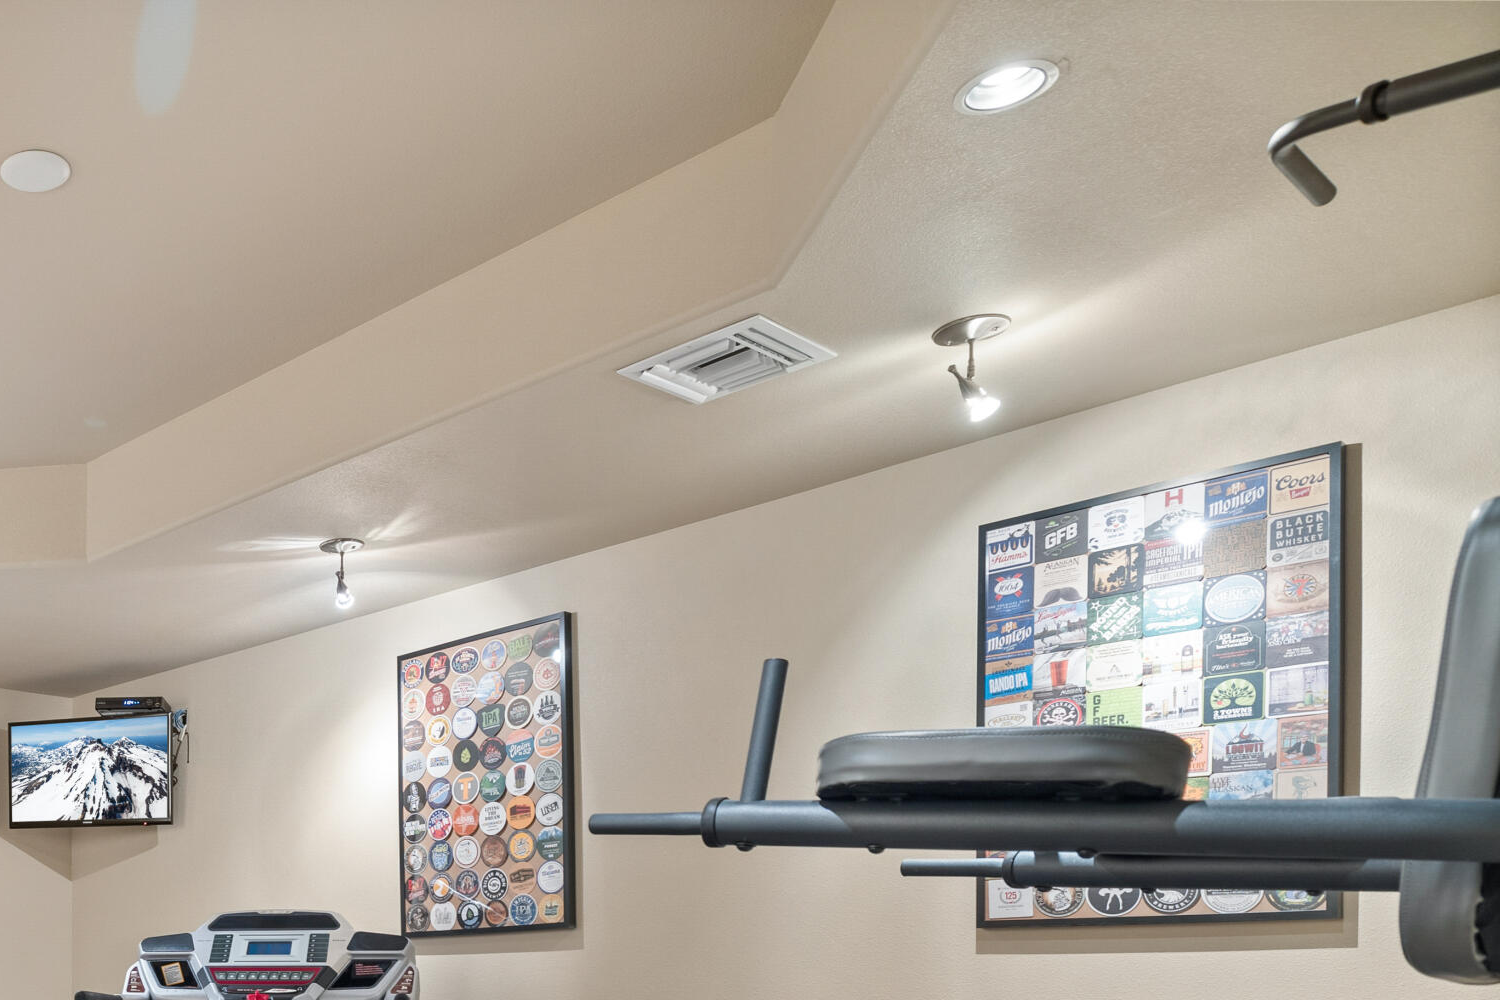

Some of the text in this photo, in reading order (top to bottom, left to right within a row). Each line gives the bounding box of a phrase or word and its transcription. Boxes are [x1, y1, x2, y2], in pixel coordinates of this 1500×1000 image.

[1275, 472, 1325, 491] Coors
[1208, 485, 1265, 518] Montejo
[1275, 512, 1324, 529] BLACK
[1044, 522, 1078, 550] GFB
[1275, 523, 1324, 540] BUTTE
[1275, 533, 1324, 548] WHISKEY
[987, 626, 1032, 652] Montejo
[988, 671, 1029, 693] RANDO IPA
[1092, 695, 1101, 706] G
[484, 711, 499, 727] IPA
[1092, 706, 1101, 717] F
[1092, 714, 1129, 727] BEER.
[540, 801, 560, 816] LOSER
[1004, 892, 1017, 900] 125
